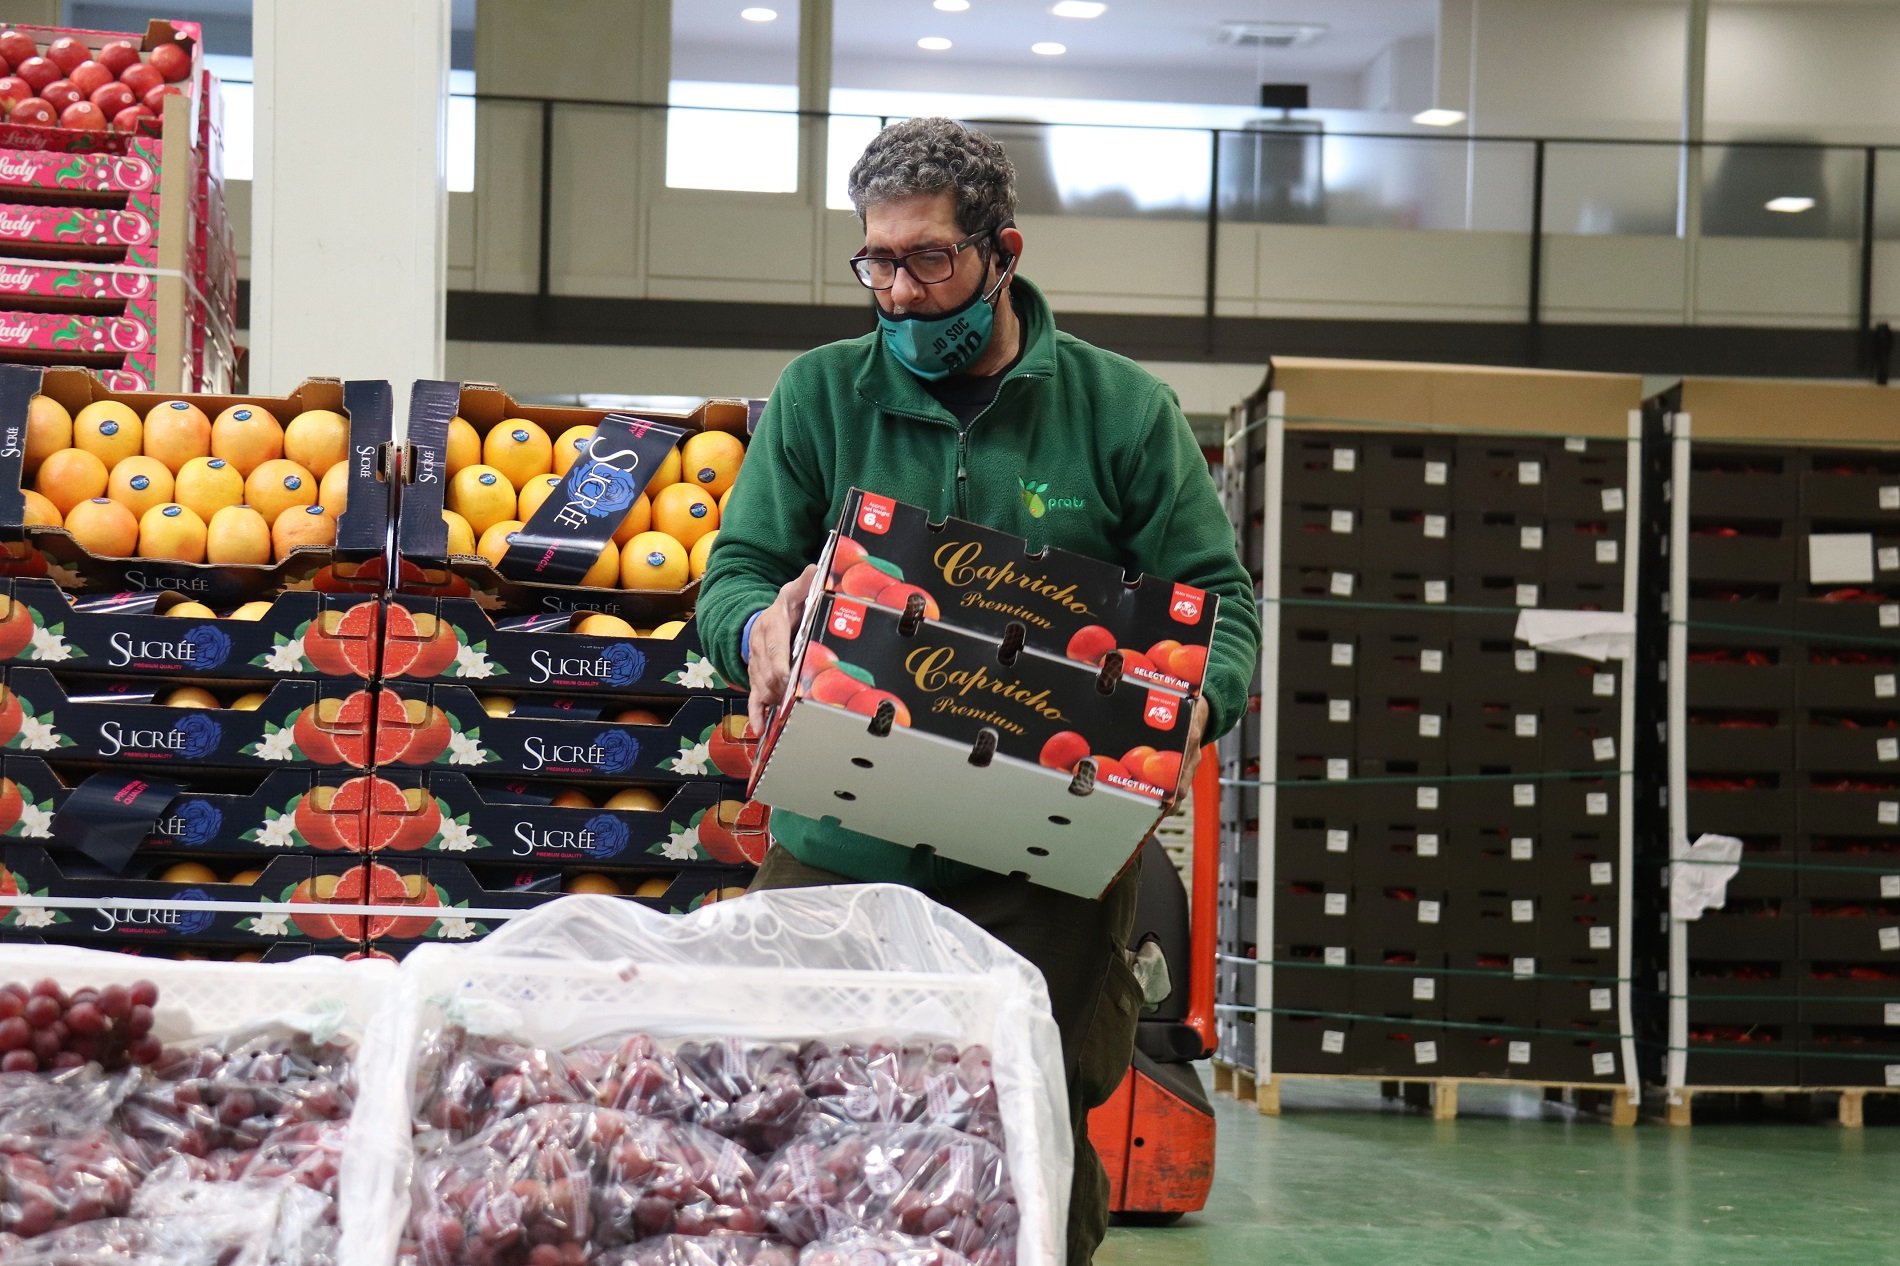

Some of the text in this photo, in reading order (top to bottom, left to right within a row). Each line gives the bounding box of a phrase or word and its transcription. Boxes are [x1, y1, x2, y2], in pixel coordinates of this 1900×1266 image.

[553, 436, 639, 530] SUCRÉE
[125, 570, 210, 592] SUCRÉE
[933, 541, 1098, 618] Capricho
[960, 591, 1055, 630] Premium
[108, 631, 197, 667] SUCRÉE
[529, 649, 613, 684] SUCRÉE
[905, 646, 1072, 723] Capricho
[1134, 666, 1190, 689] SELECT BY AIR
[931, 696, 1029, 736] Premium
[98, 721, 187, 756] SUCRÉE
[522, 736, 606, 771] SUCRÉE
[1107, 774, 1139, 789] SELECT
[1150, 786, 1165, 797] AIR
[148, 815, 187, 836] RÉE
[512, 821, 596, 856] SUCRÉE
